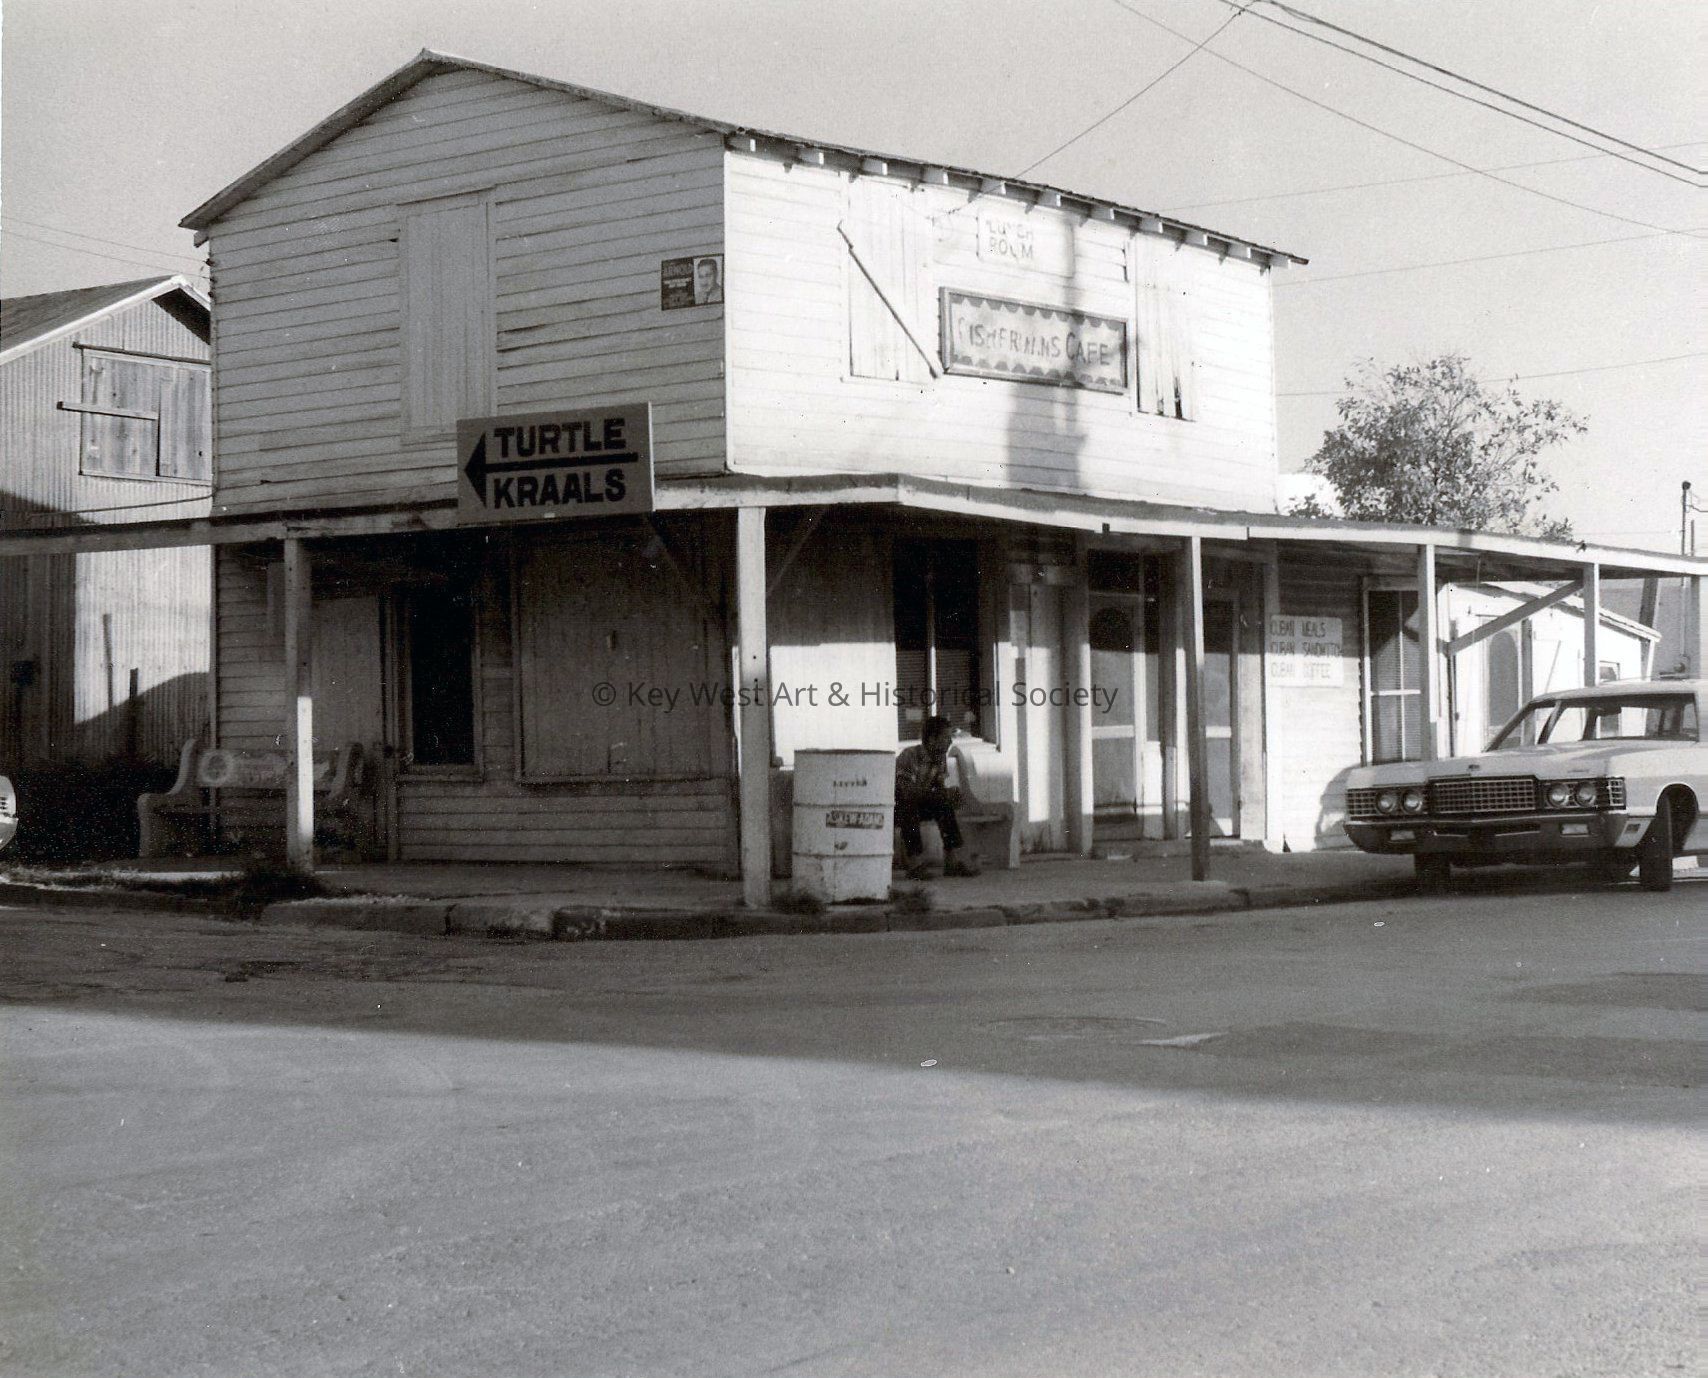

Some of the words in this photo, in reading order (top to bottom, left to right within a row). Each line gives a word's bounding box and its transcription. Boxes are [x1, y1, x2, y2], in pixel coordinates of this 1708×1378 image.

[1066, 331, 1110, 366] CAFE
[494, 418, 626, 458] TURTLE
[494, 468, 626, 509] KRAALS
